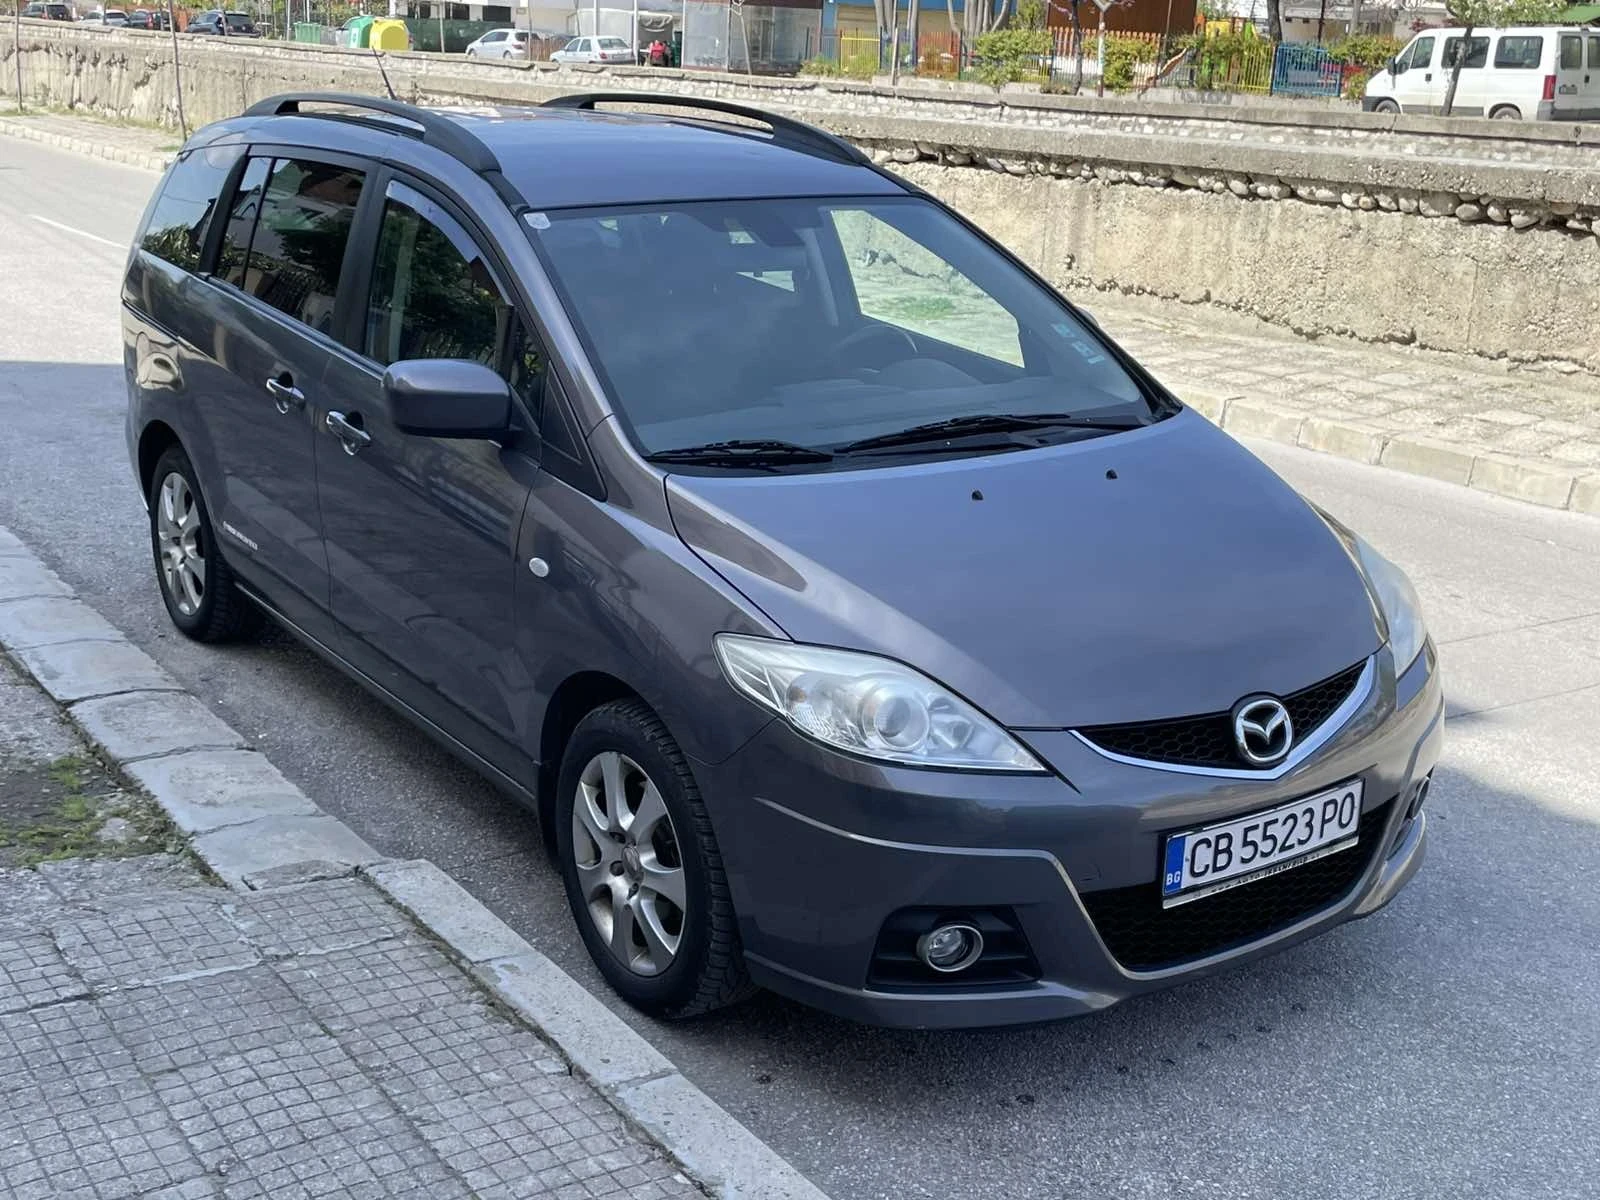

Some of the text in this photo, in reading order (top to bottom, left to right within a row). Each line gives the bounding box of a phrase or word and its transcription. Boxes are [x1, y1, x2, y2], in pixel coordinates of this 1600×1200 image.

[1189, 832, 1233, 879] CB
[1240, 807, 1315, 865] 5523
[1319, 792, 1355, 840] PO
[1166, 870, 1181, 887] BG
